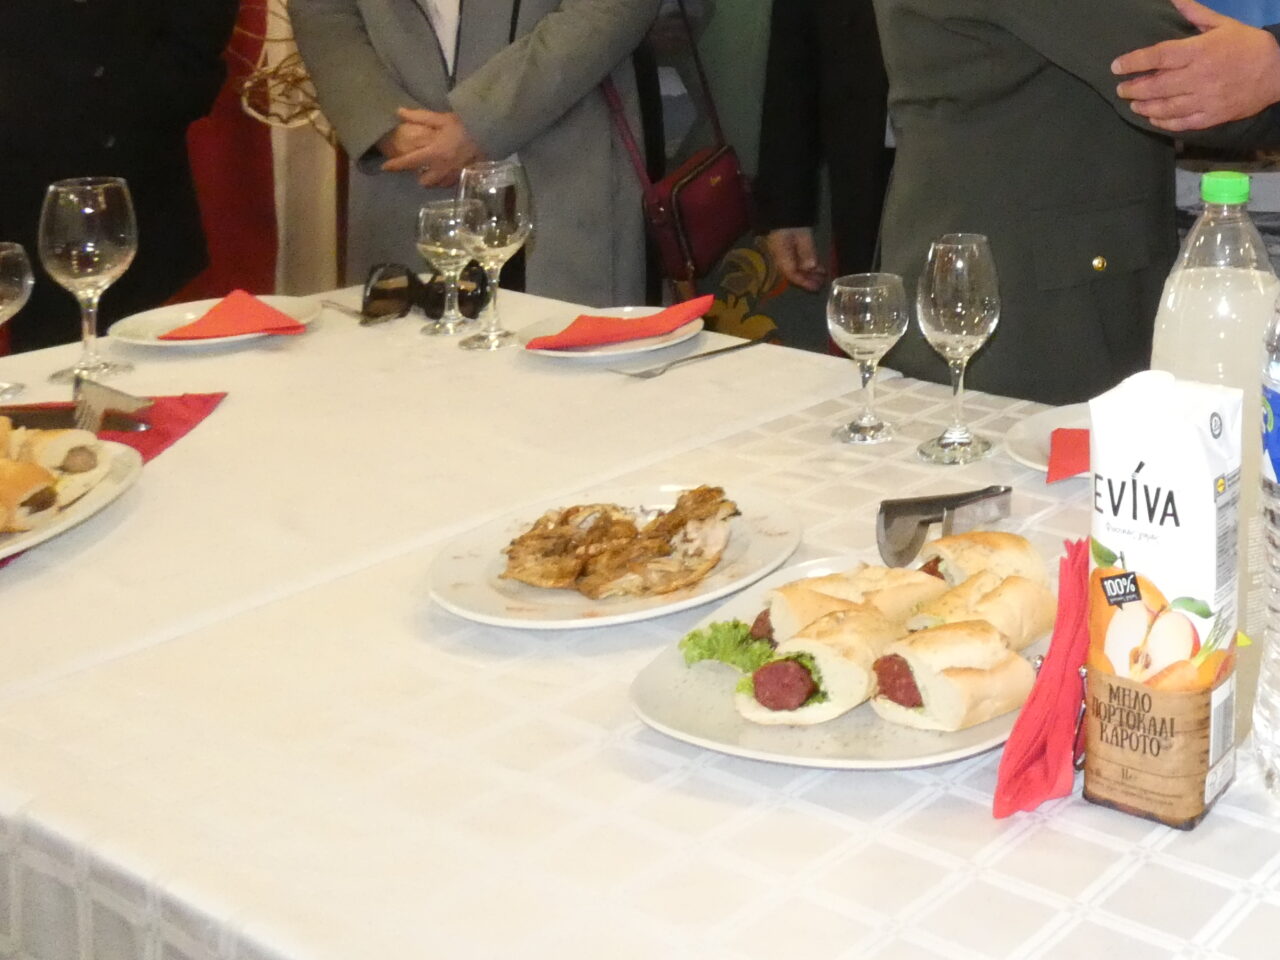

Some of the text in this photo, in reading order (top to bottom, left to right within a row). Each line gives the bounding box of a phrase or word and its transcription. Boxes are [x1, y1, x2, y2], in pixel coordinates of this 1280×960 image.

[1104, 574, 1136, 596] 100%
[1108, 683, 1152, 713] ΜΗΛΟ
[1091, 695, 1175, 738] ΠΟΡΤΟΚΑΛΙ
[1100, 721, 1160, 757] ΚΑΡΟΤΟ
